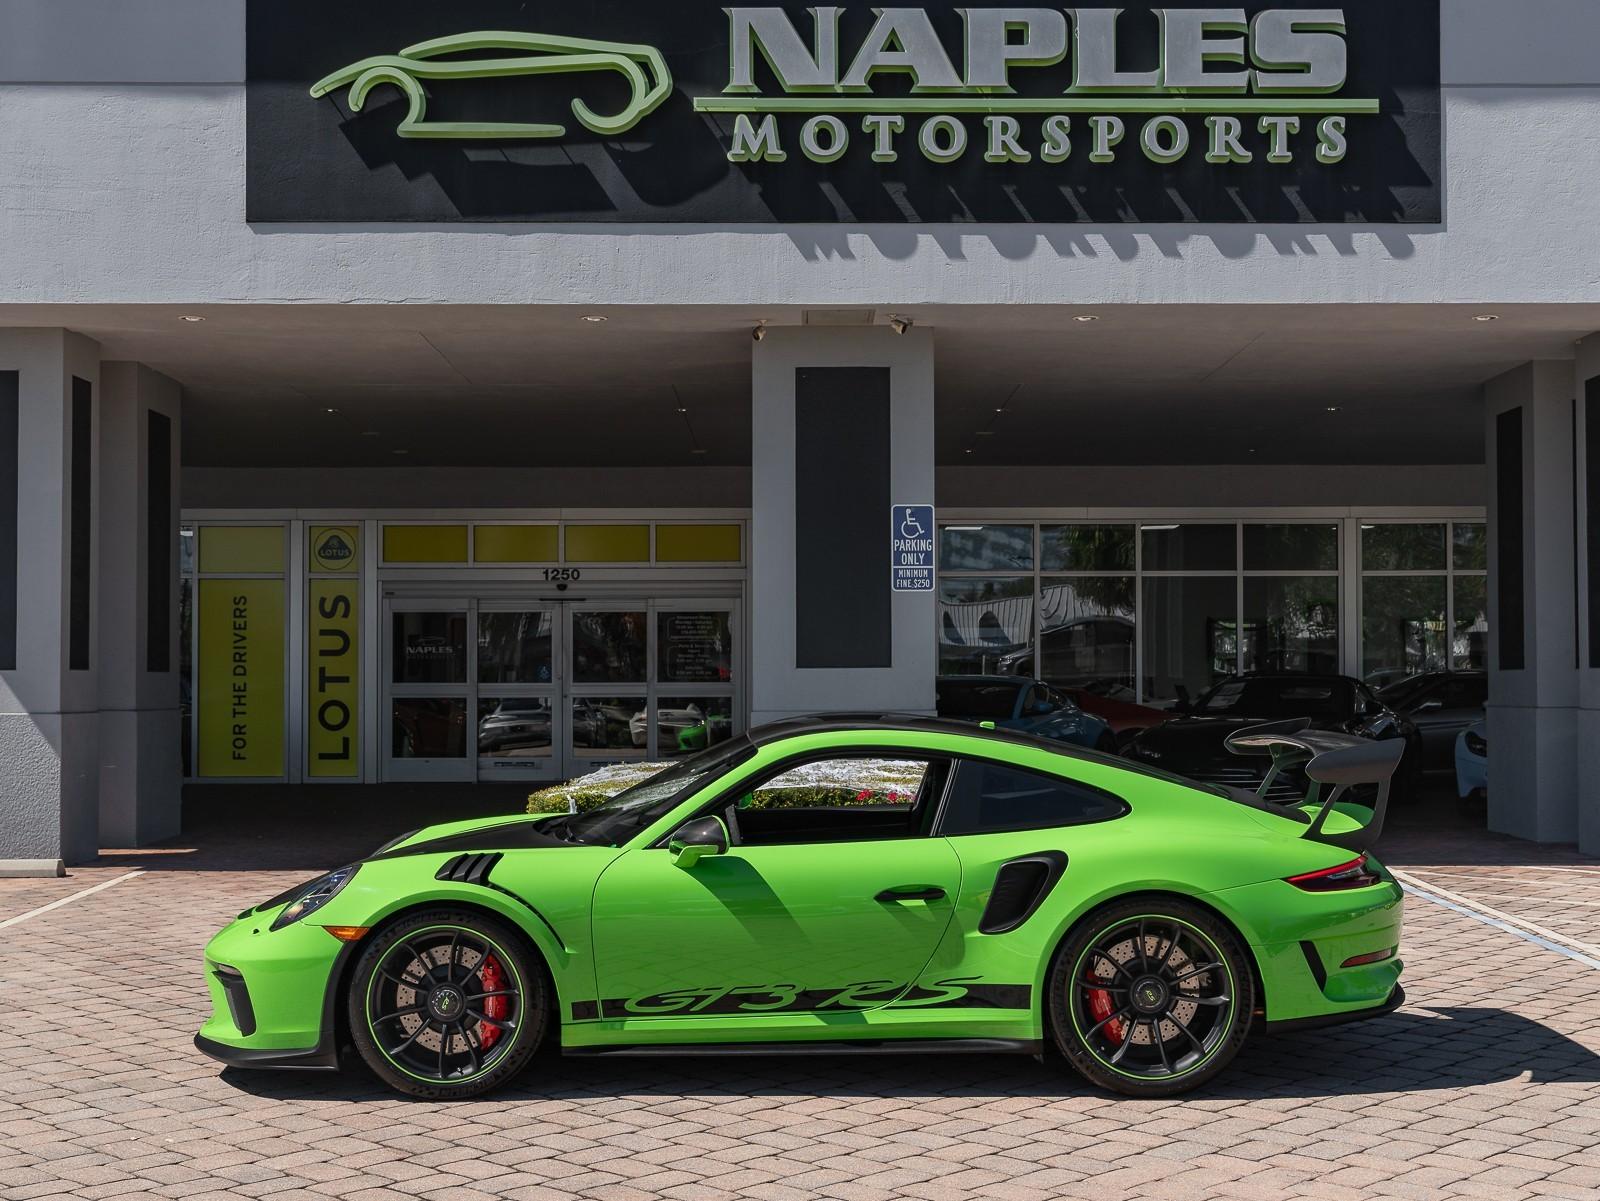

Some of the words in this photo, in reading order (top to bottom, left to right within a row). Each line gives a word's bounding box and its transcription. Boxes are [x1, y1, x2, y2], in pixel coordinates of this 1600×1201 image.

[722, 7, 1347, 94] NAPLES
[727, 114, 1347, 164] MOTORSPORTS
[319, 548, 351, 557] LOTUS
[894, 539, 932, 551] PARKING
[901, 553, 925, 565] ONLY
[543, 568, 580, 582] 1250
[898, 569, 928, 578] MINIMUM
[232, 595, 248, 677] DRIVERS
[406, 646, 454, 654] NAPLES
[318, 594, 350, 760] LOTUS
[232, 682, 248, 718] THE
[232, 725, 248, 760] FOR
[624, 984, 803, 1013] GT3
[815, 975, 984, 1009] RS
